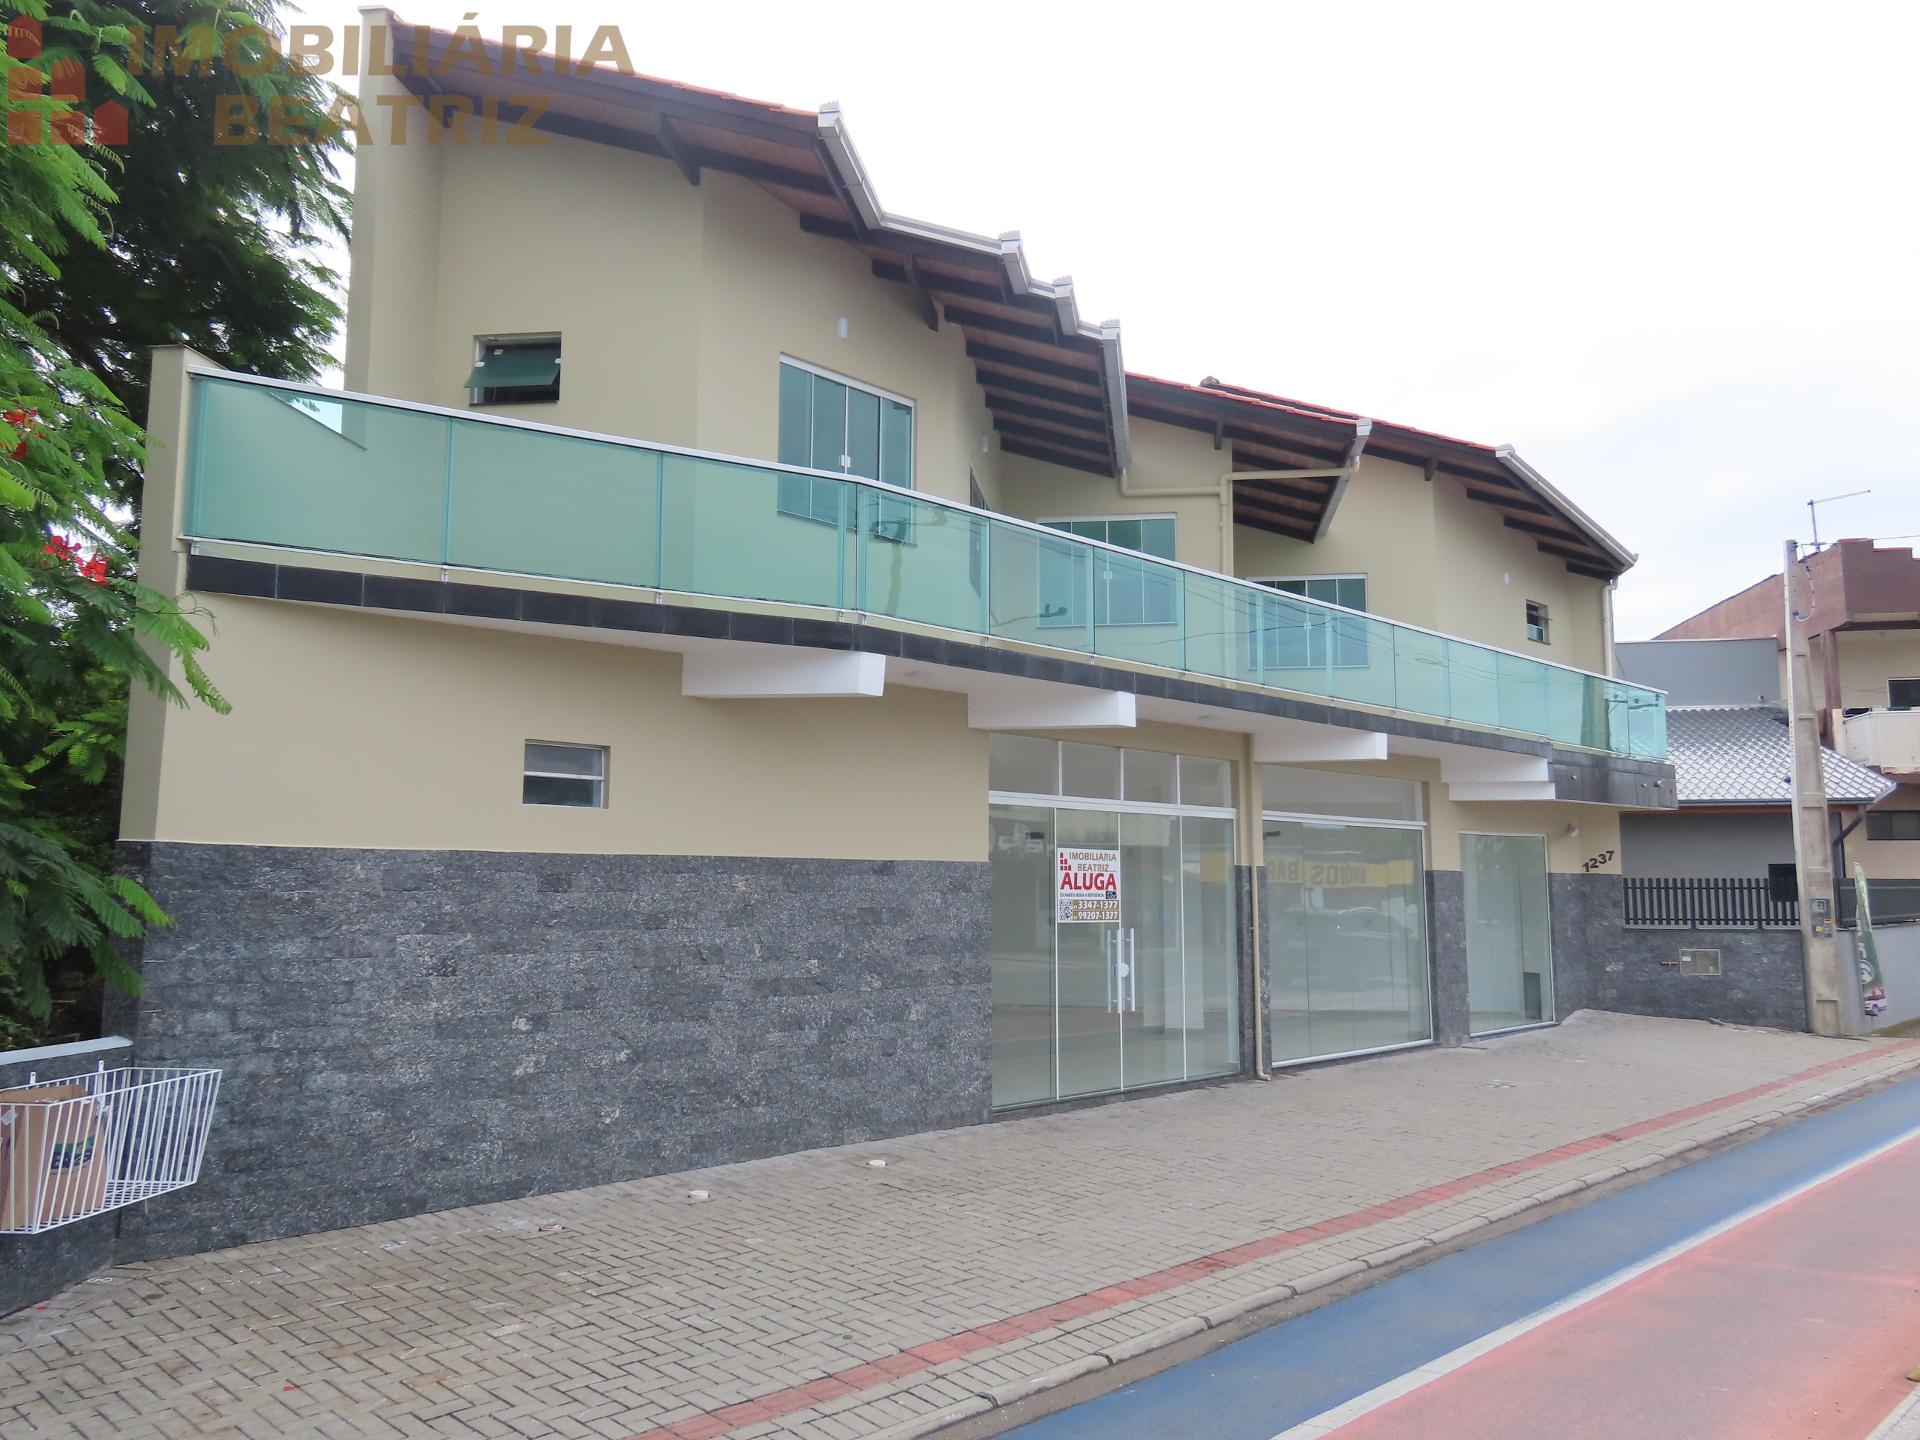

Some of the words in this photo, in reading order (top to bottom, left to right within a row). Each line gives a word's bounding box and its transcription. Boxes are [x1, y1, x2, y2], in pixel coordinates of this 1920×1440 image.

[1069, 851, 1117, 861] IMOBILIÁRIA
[1582, 850, 1615, 872] 1237
[1077, 863, 1109, 872] BEATRIZ
[1060, 872, 1117, 890] ALUGA
[1078, 900, 1118, 909] 3347-1377
[1078, 911, 1118, 920] 99207-1377
